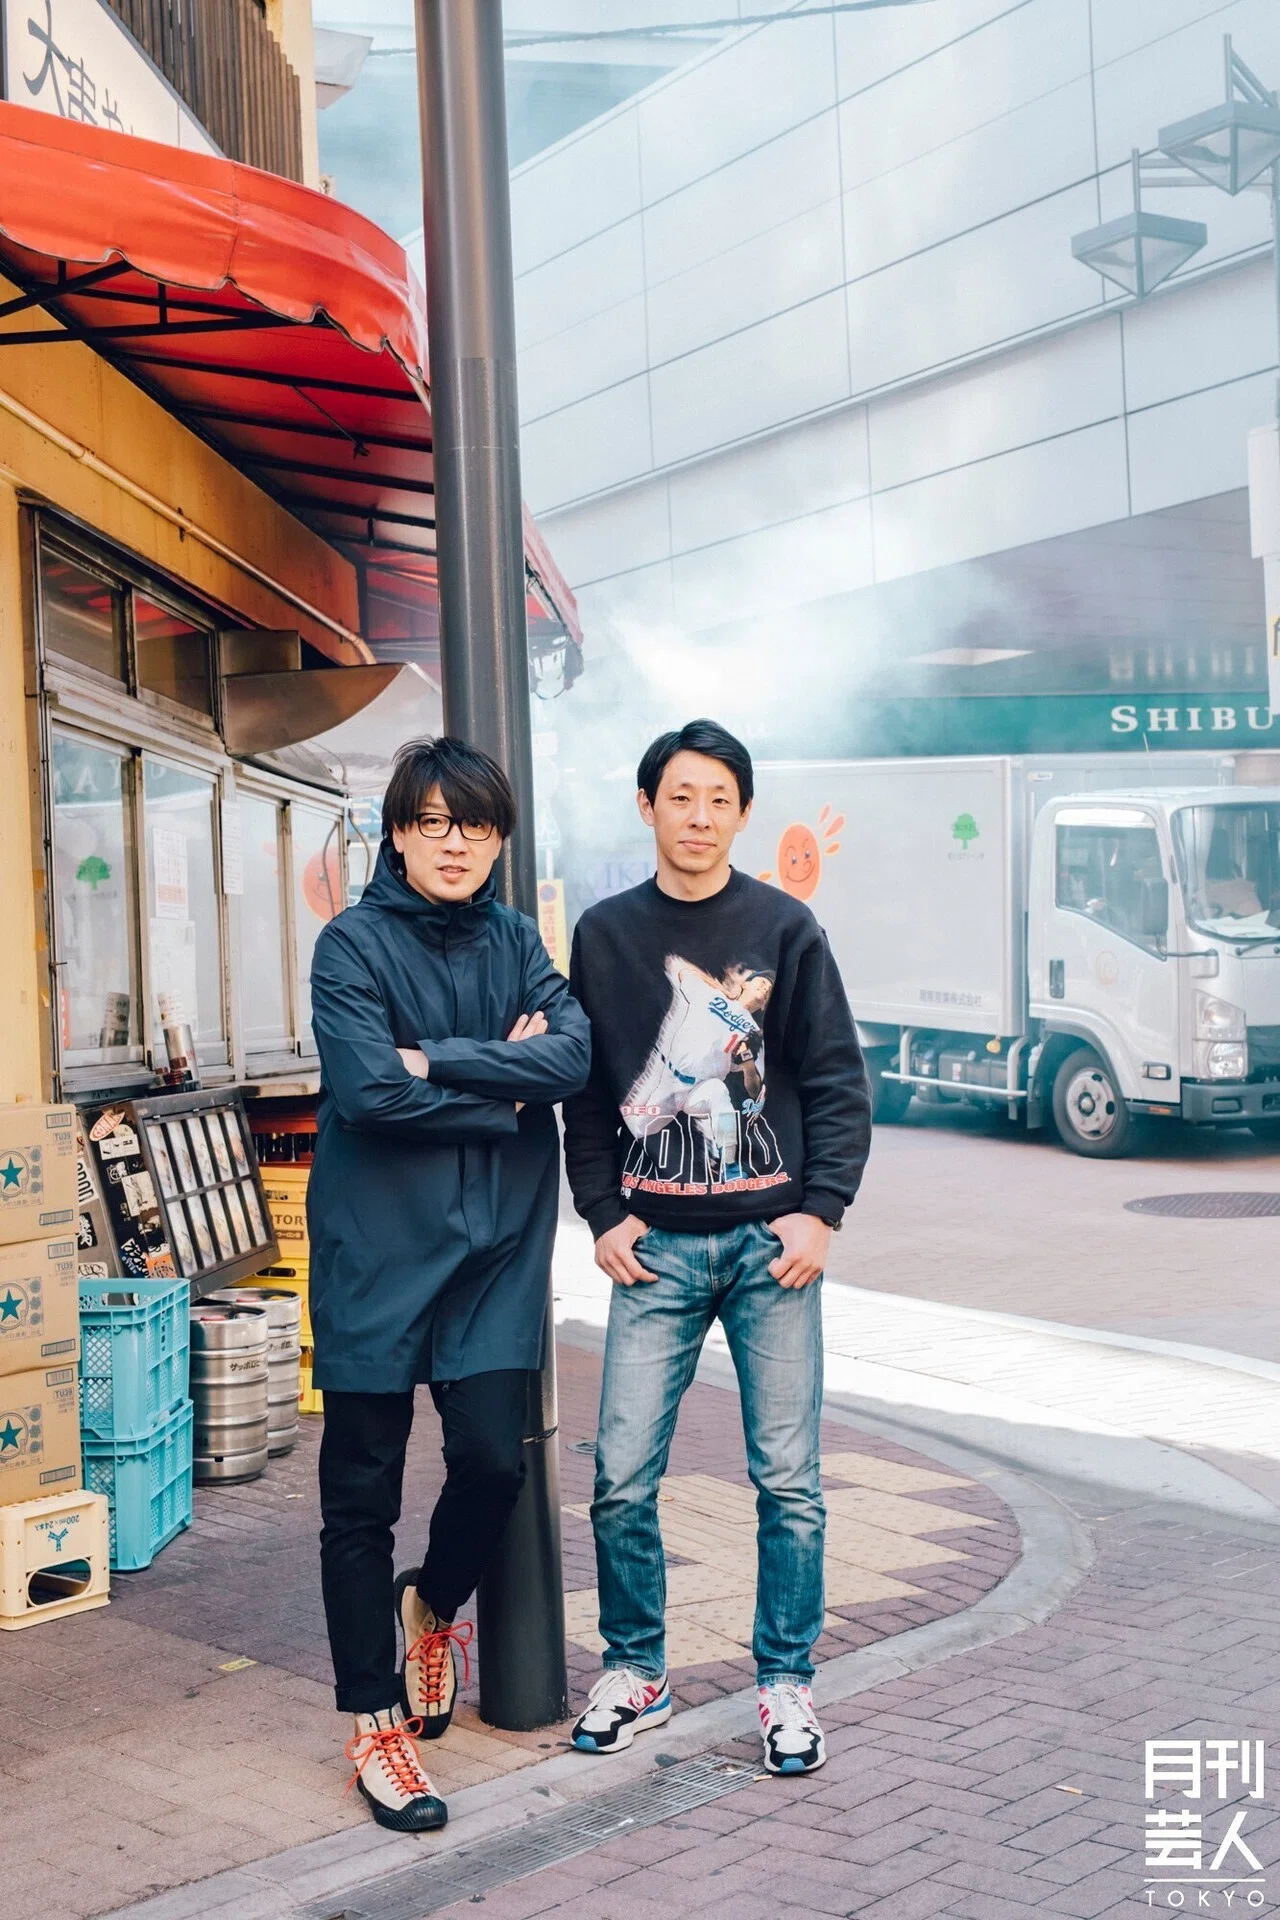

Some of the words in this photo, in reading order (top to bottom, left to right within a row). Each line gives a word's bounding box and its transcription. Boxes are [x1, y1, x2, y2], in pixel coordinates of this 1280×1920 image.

[1111, 705, 1273, 732] SHIBU
[620, 1105, 661, 1117] DEO
[639, 1178, 708, 1196] ANGELES
[271, 1213, 307, 1227] TOR
